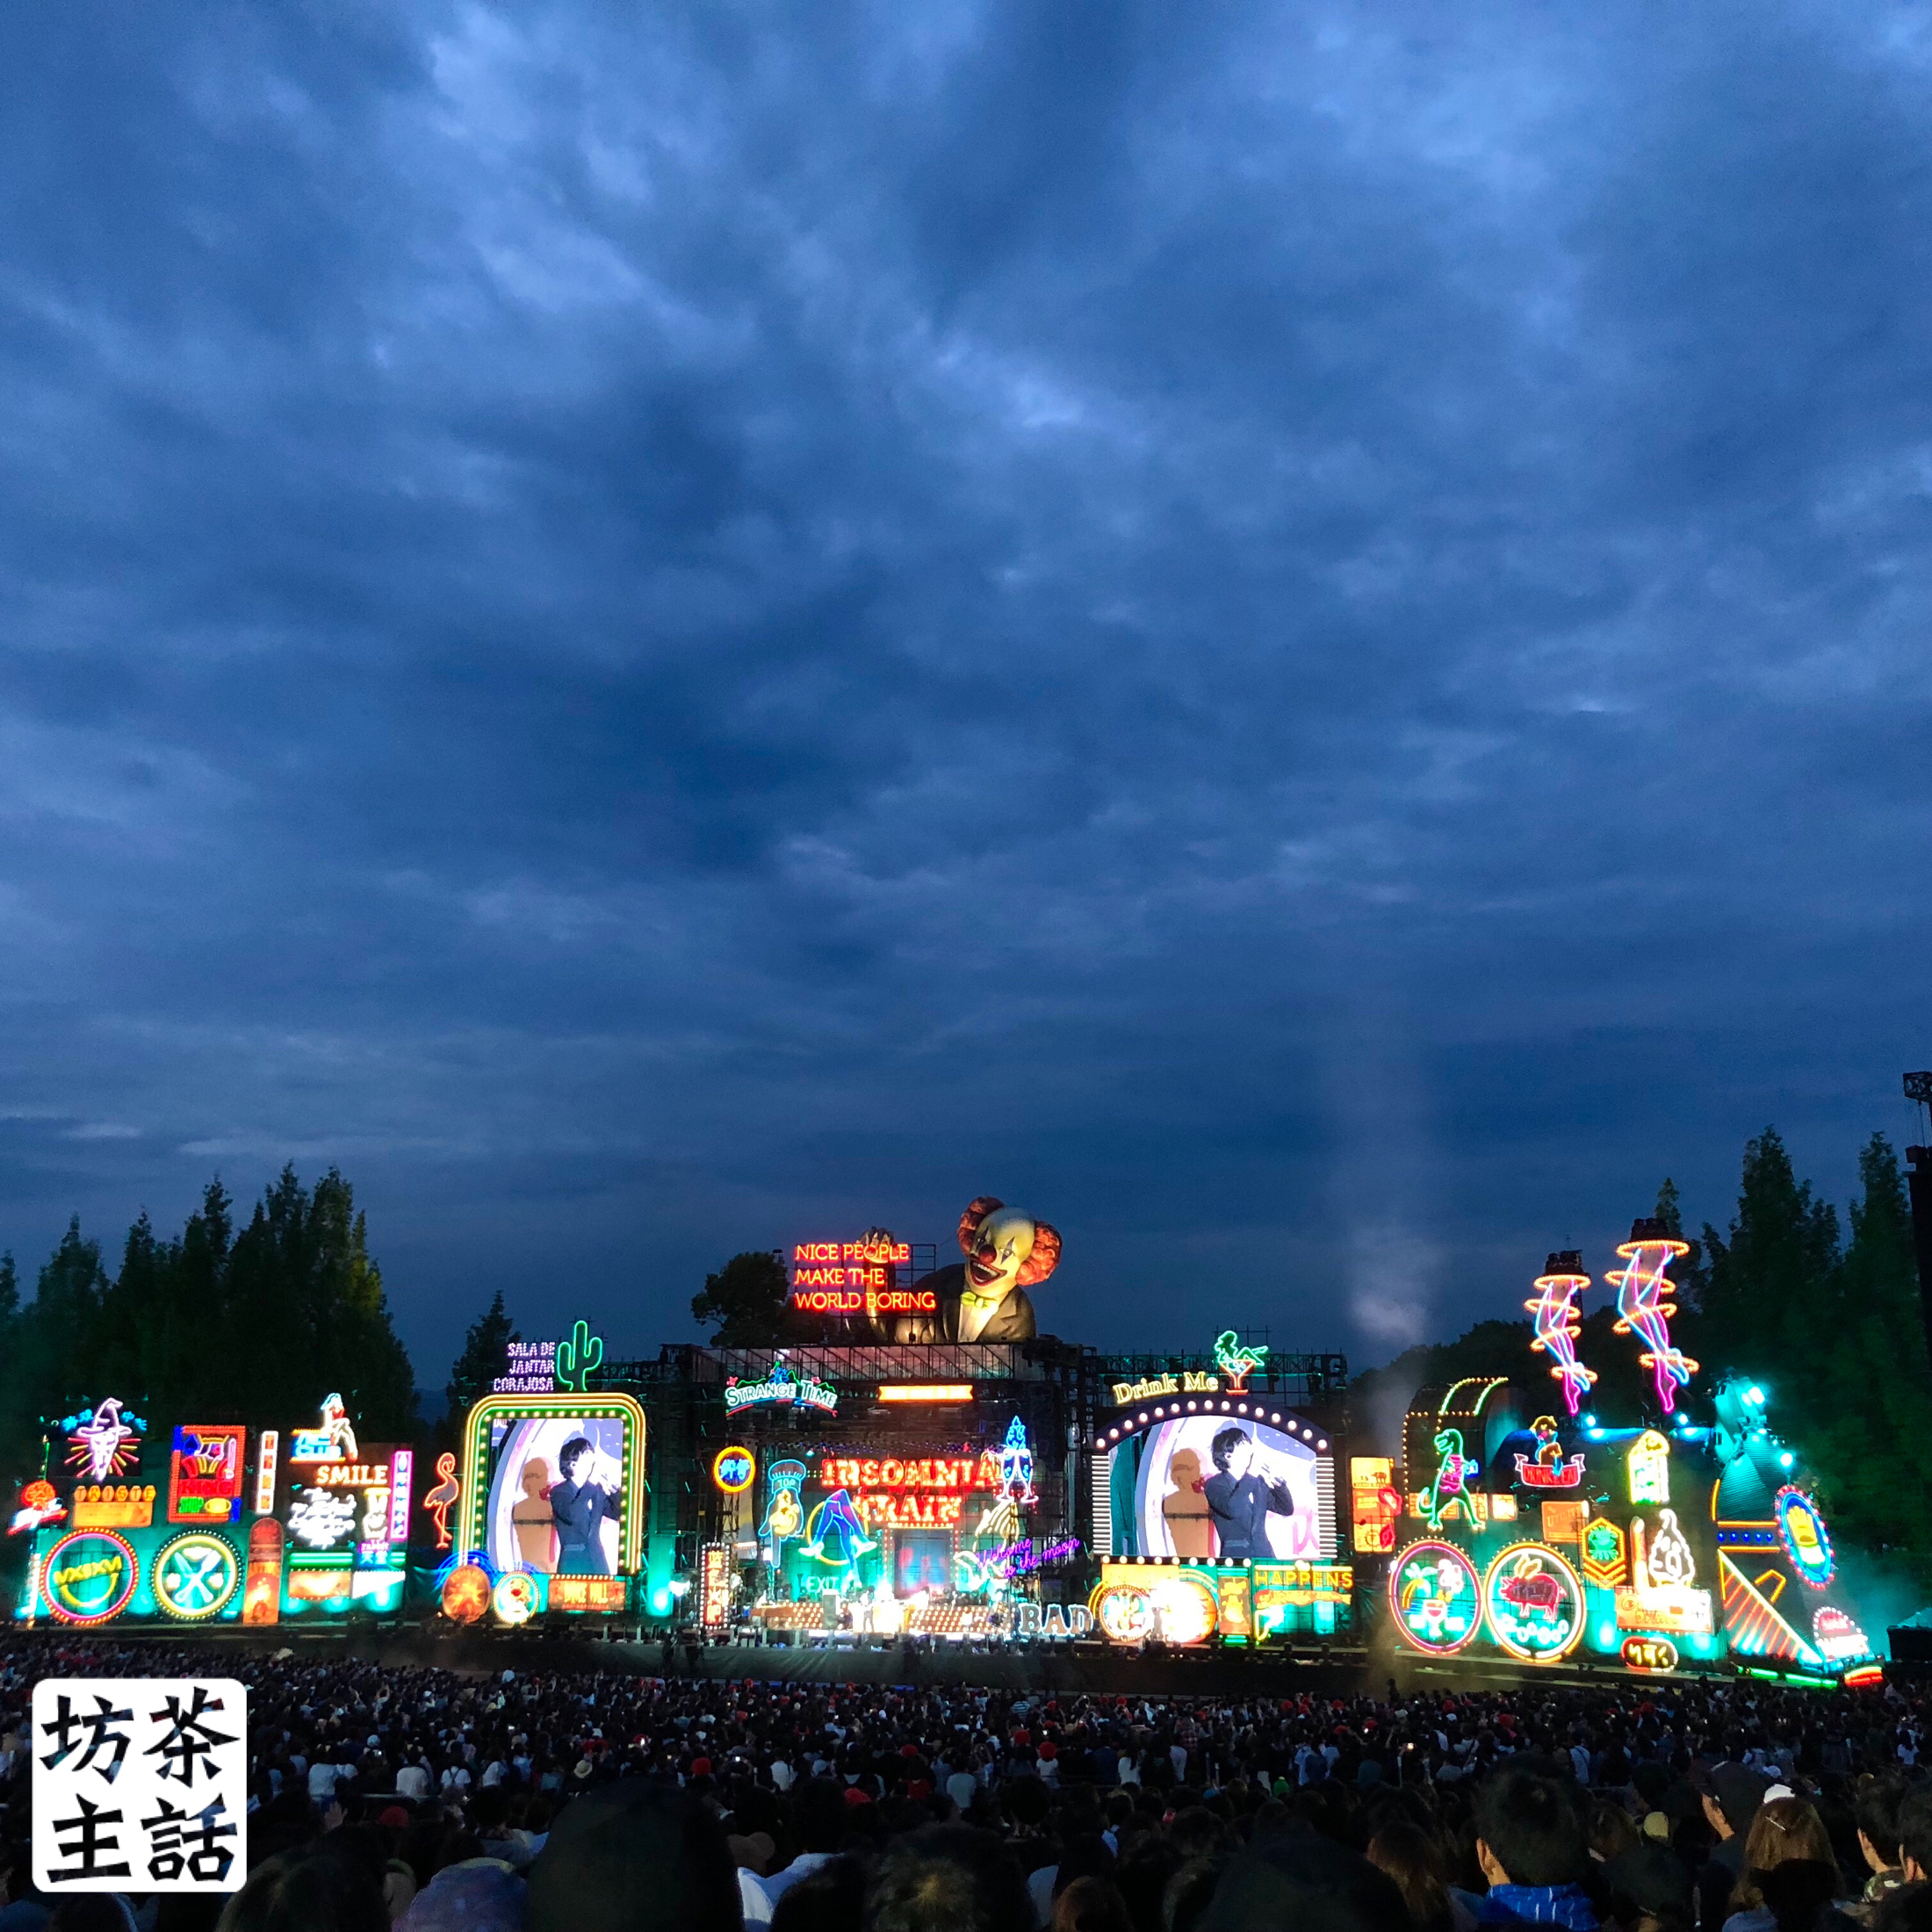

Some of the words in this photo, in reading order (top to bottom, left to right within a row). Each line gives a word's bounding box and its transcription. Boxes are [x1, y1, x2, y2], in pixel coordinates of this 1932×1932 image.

[795, 1244, 839, 1260] NICE
[843, 1244, 909, 1261] PEOPLE
[794, 1268, 844, 1285] MAKE
[848, 1268, 884, 1285] THE
[795, 1292, 861, 1308] WORLD
[866, 1291, 936, 1309] BORING
[508, 1342, 537, 1357] SALA
[540, 1342, 555, 1356] DE
[508, 1359, 555, 1374] JANTAR
[494, 1377, 554, 1392] CORAJOSA
[1113, 1372, 1179, 1405] Drink
[1184, 1371, 1219, 1391] Me
[724, 1382, 797, 1407] STRANGE
[800, 1379, 838, 1409] TIME
[314, 1464, 388, 1485] SMILE
[821, 1458, 998, 1487] INSOMNIA
[76, 1485, 155, 1501] TRISTE
[181, 1481, 231, 1495] KING
[852, 1494, 962, 1523] TRAIN
[1020, 1550, 1038, 1569] the
[1042, 1538, 1080, 1562] moon
[806, 1575, 841, 1593] EXIT
[1254, 1570, 1354, 1590] HAPPENS
[1018, 1602, 1094, 1637] BAD
